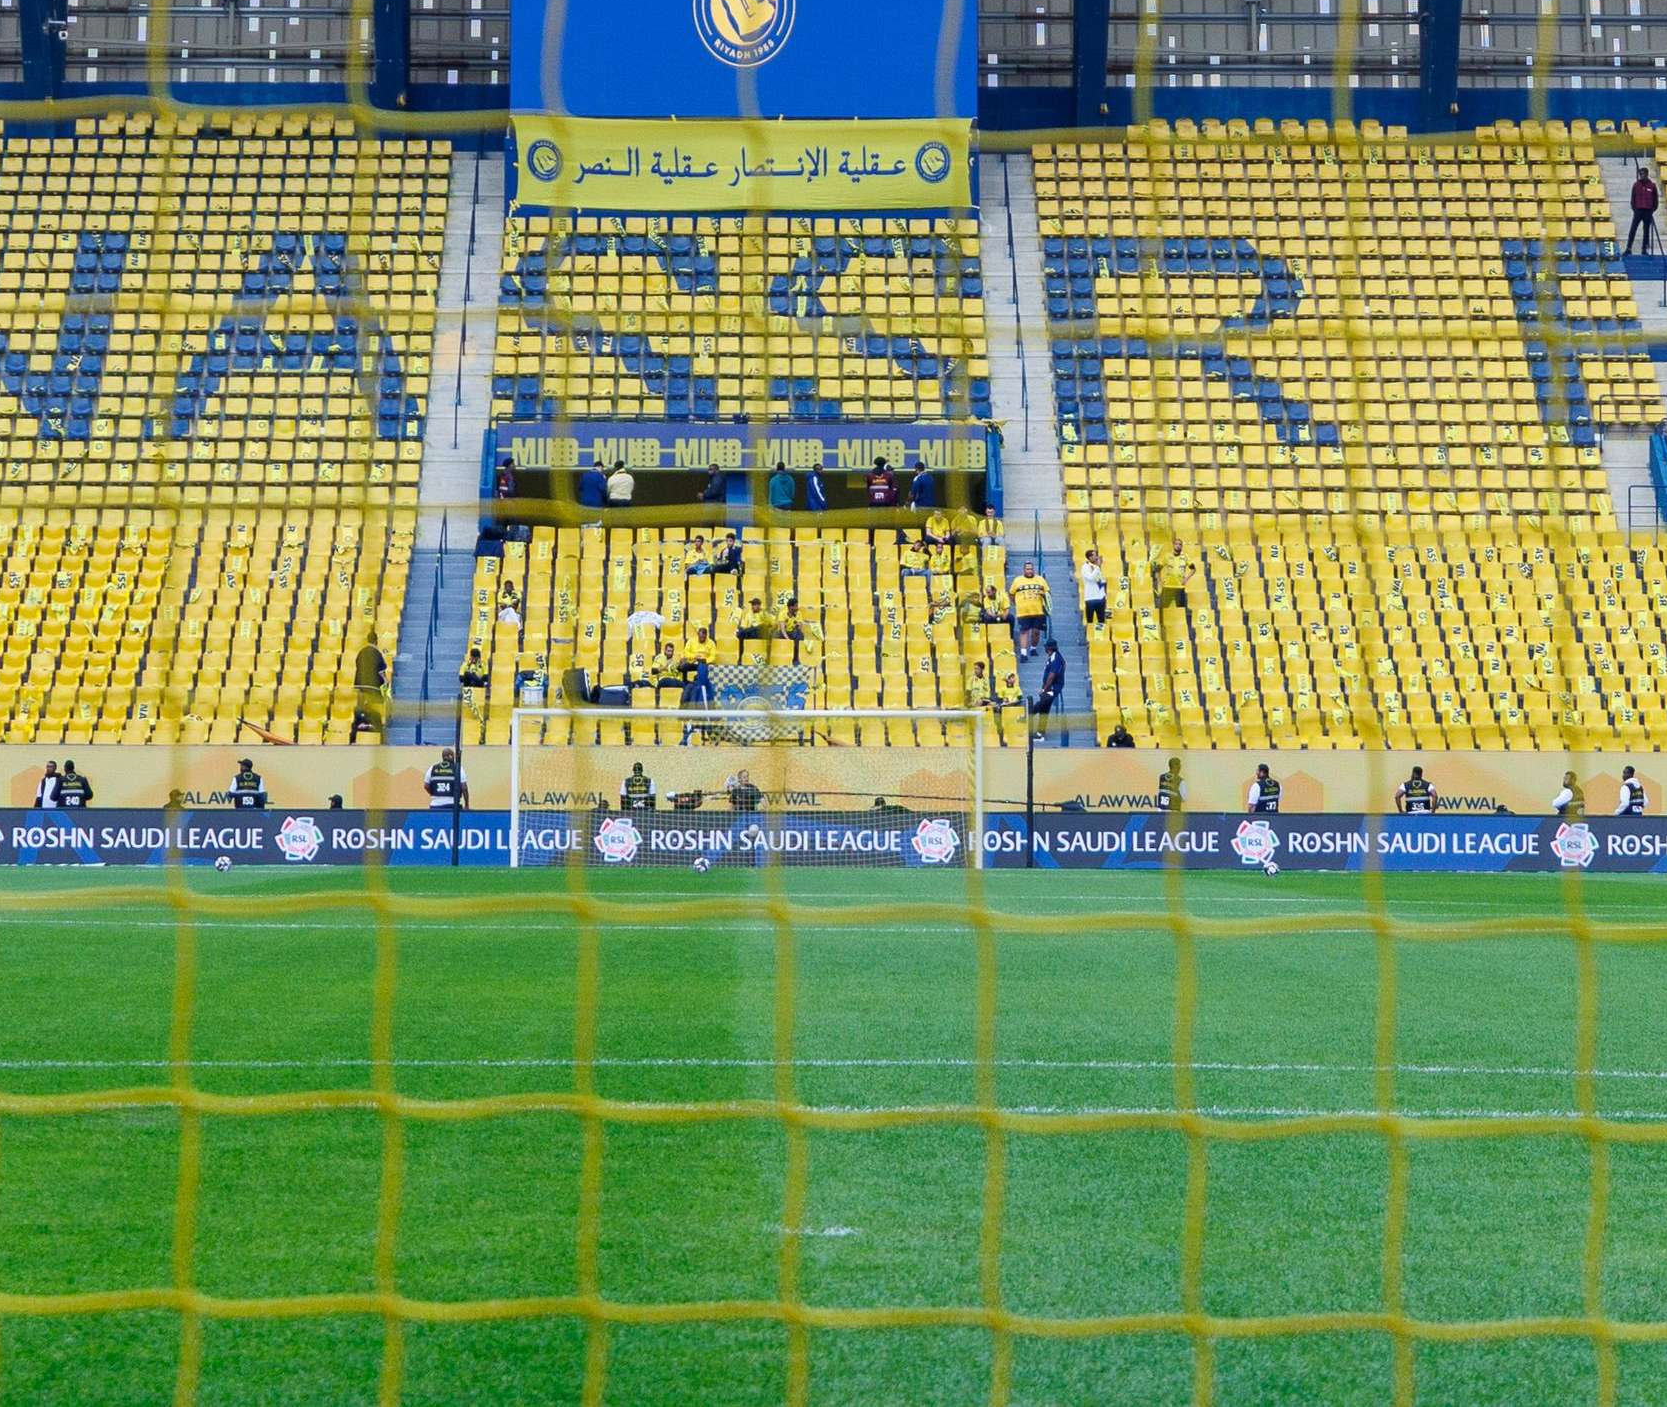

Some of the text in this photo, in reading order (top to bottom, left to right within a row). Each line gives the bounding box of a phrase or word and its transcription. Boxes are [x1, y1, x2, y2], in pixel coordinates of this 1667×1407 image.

[713, 38, 751, 59] RIYADH
[572, 145, 640, 184] النصر
[650, 145, 720, 184] عقلية
[837, 145, 907, 183] عقلية
[12, 826, 264, 849] ROSHN SAUDI LEAGUE
[332, 828, 583, 851] ROSHN SAUDI LAGUE
[651, 829, 902, 852] ROSHN SAUDI LEAGUE
[1056, 831, 1127, 853] SAUDI
[1132, 831, 1220, 853] LEAGUE
[1288, 832, 1540, 855] ROSHN SAUDI LEAGUE
